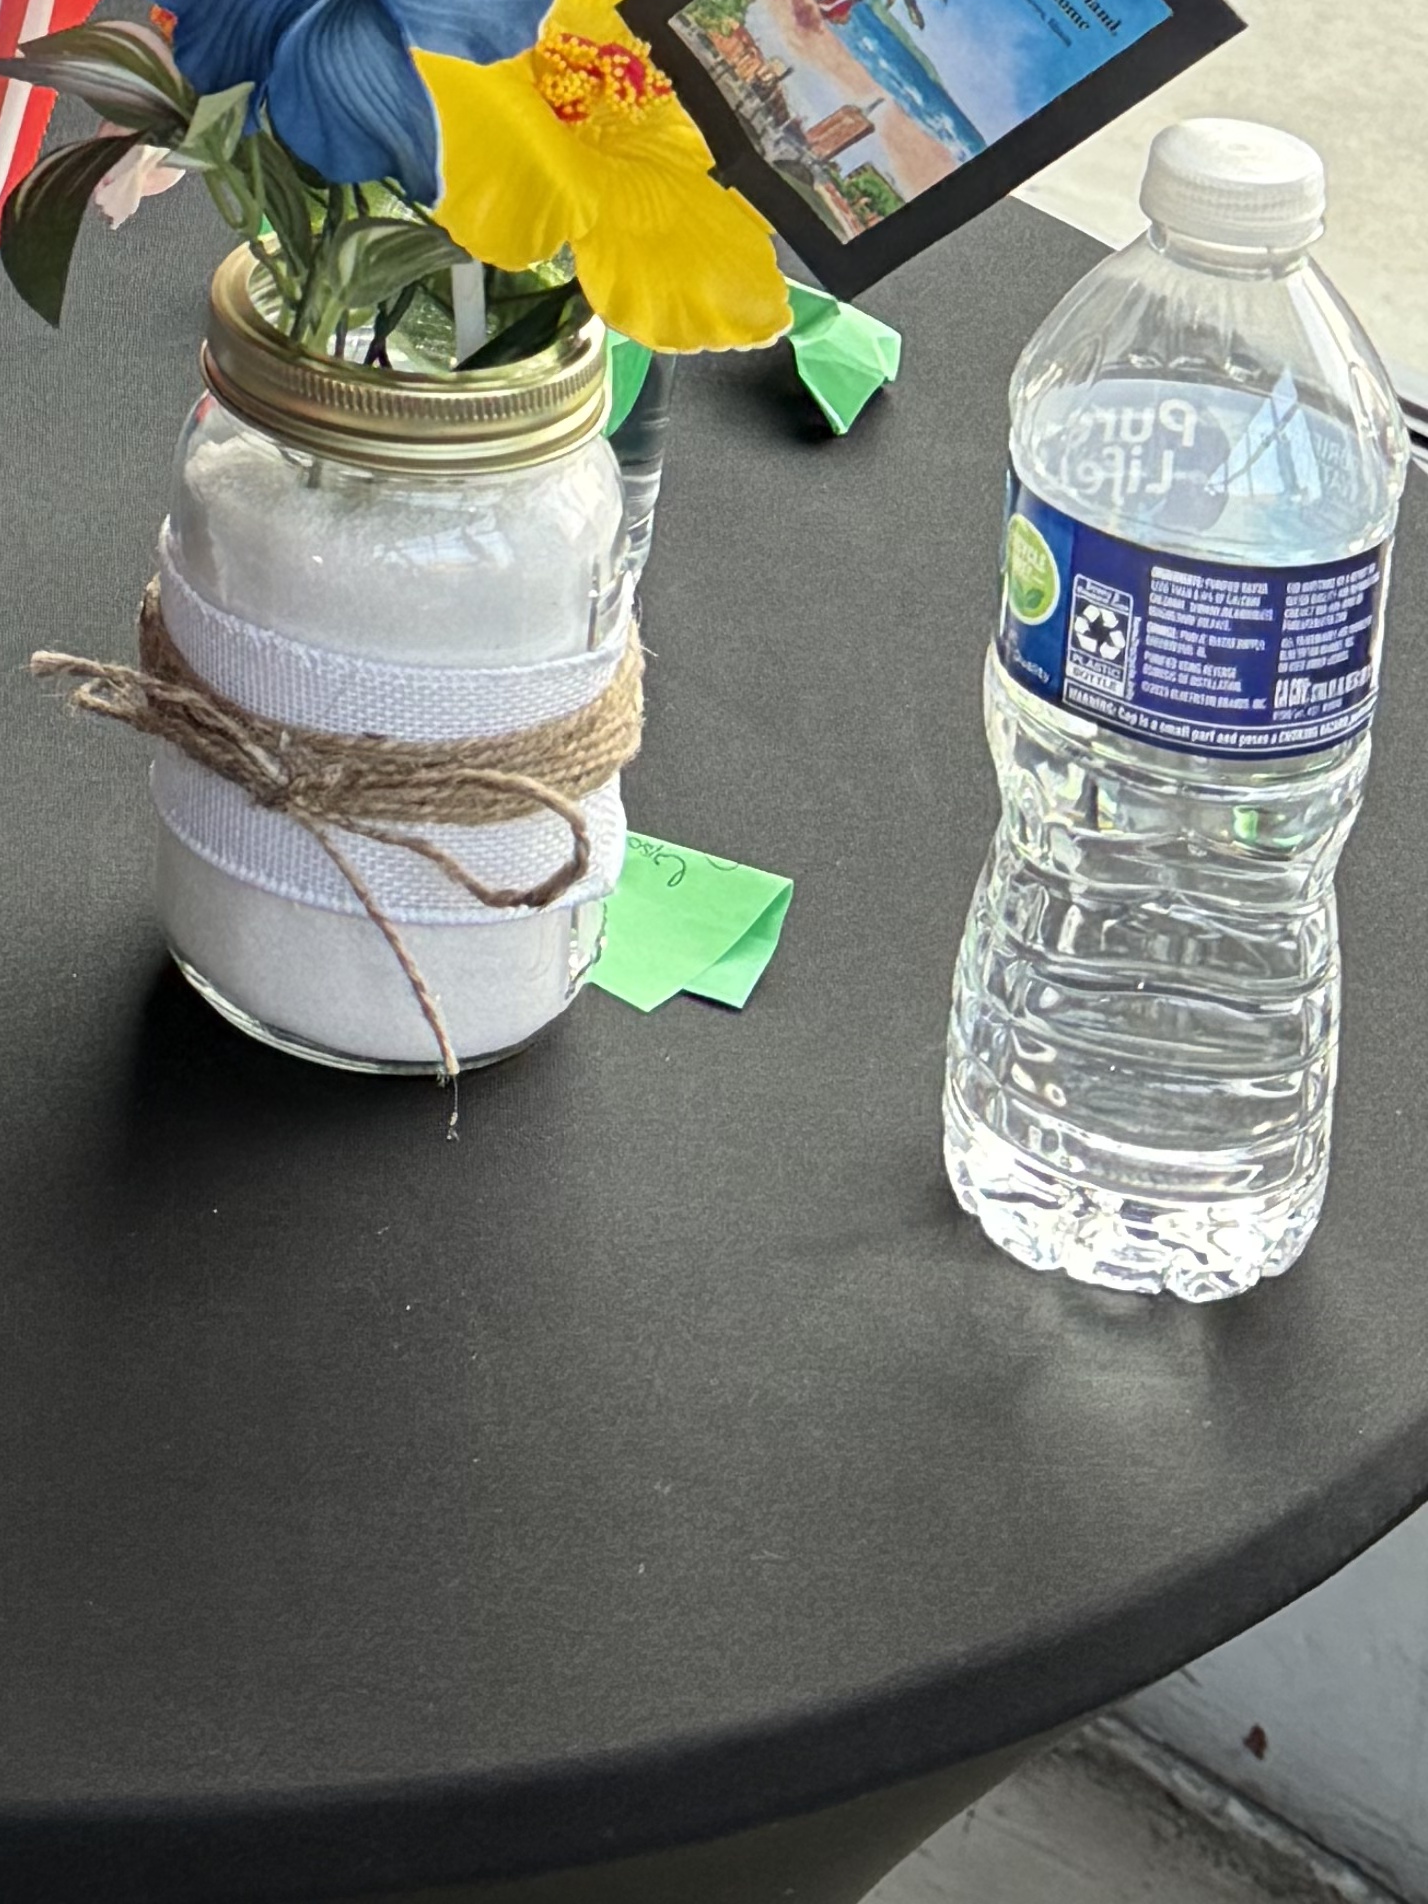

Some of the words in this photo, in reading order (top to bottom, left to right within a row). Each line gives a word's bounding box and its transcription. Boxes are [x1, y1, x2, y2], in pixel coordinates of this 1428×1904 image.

[1071, 653, 1122, 679] PLASTIC
[1071, 666, 1118, 690] BOTTLE
[1069, 687, 1116, 716] WARNING:
[1160, 722, 1190, 738] small
[1192, 729, 1215, 743] part
[1217, 732, 1237, 743] and
[1239, 733, 1270, 747] poses
